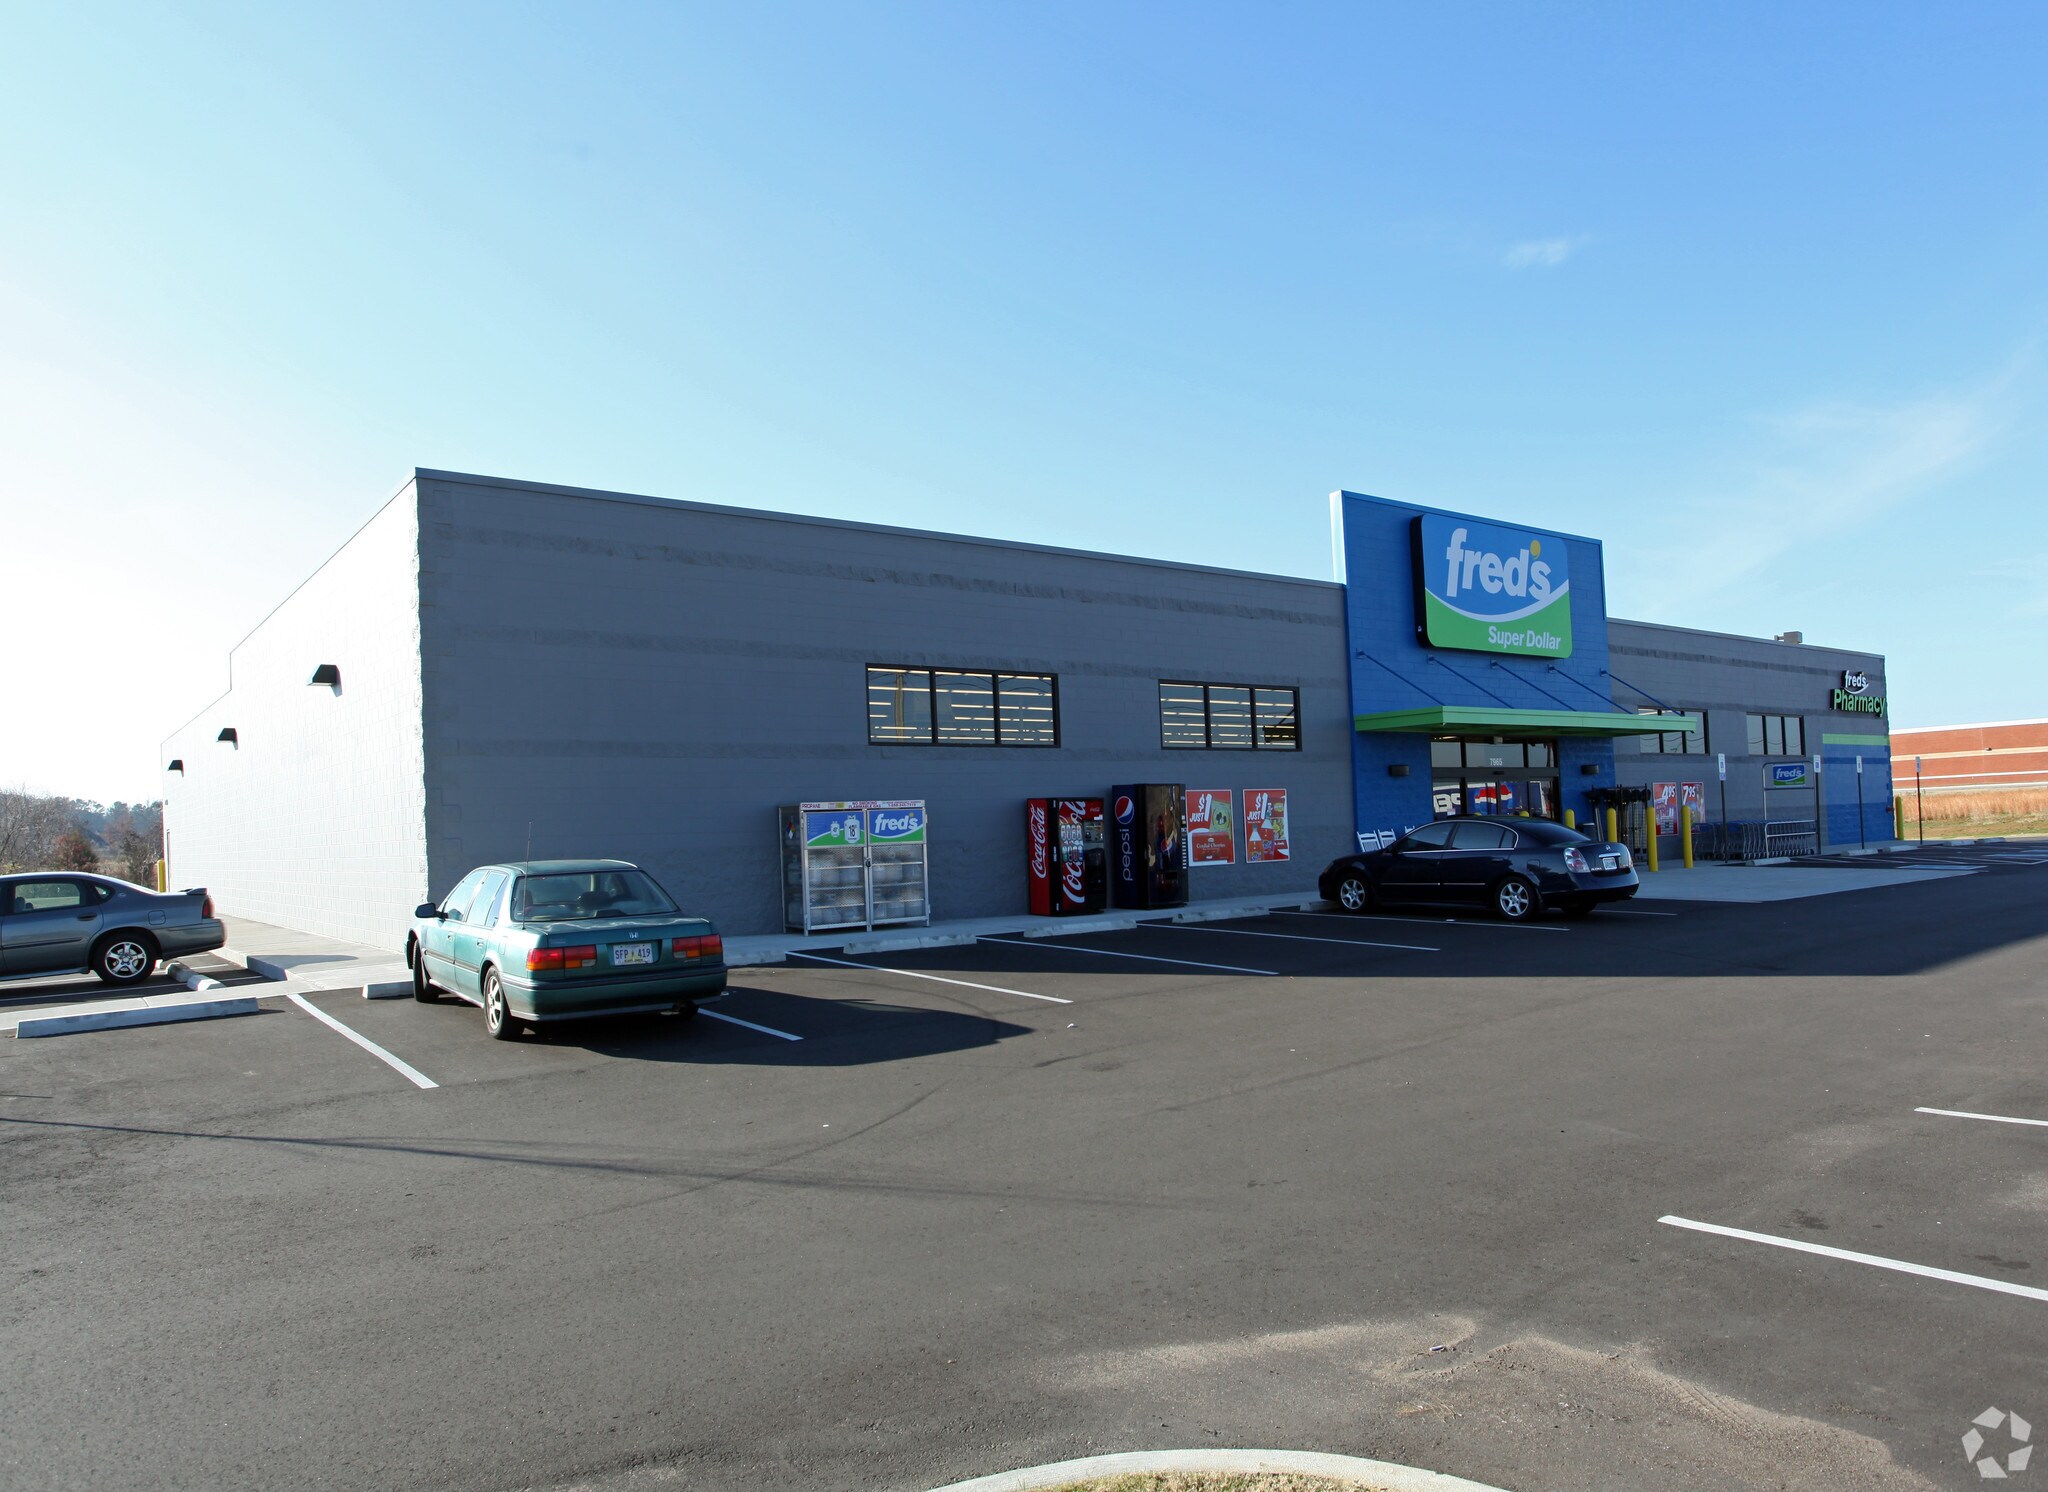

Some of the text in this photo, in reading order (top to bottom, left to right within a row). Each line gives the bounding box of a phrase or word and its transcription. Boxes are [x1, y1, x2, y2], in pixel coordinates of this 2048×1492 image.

[1446, 528, 1551, 600] fred's
[1488, 626, 1561, 650] Super Dollar
[1845, 670, 1867, 688] fred's
[1834, 688, 1885, 717] Pharmacy
[1490, 758, 1503, 766] 7965
[1190, 812, 1205, 822] JUST
[1247, 811, 1261, 820] JUST
[1030, 804, 1047, 879] Coca-Cola
[1120, 829, 1133, 881] pepsi
